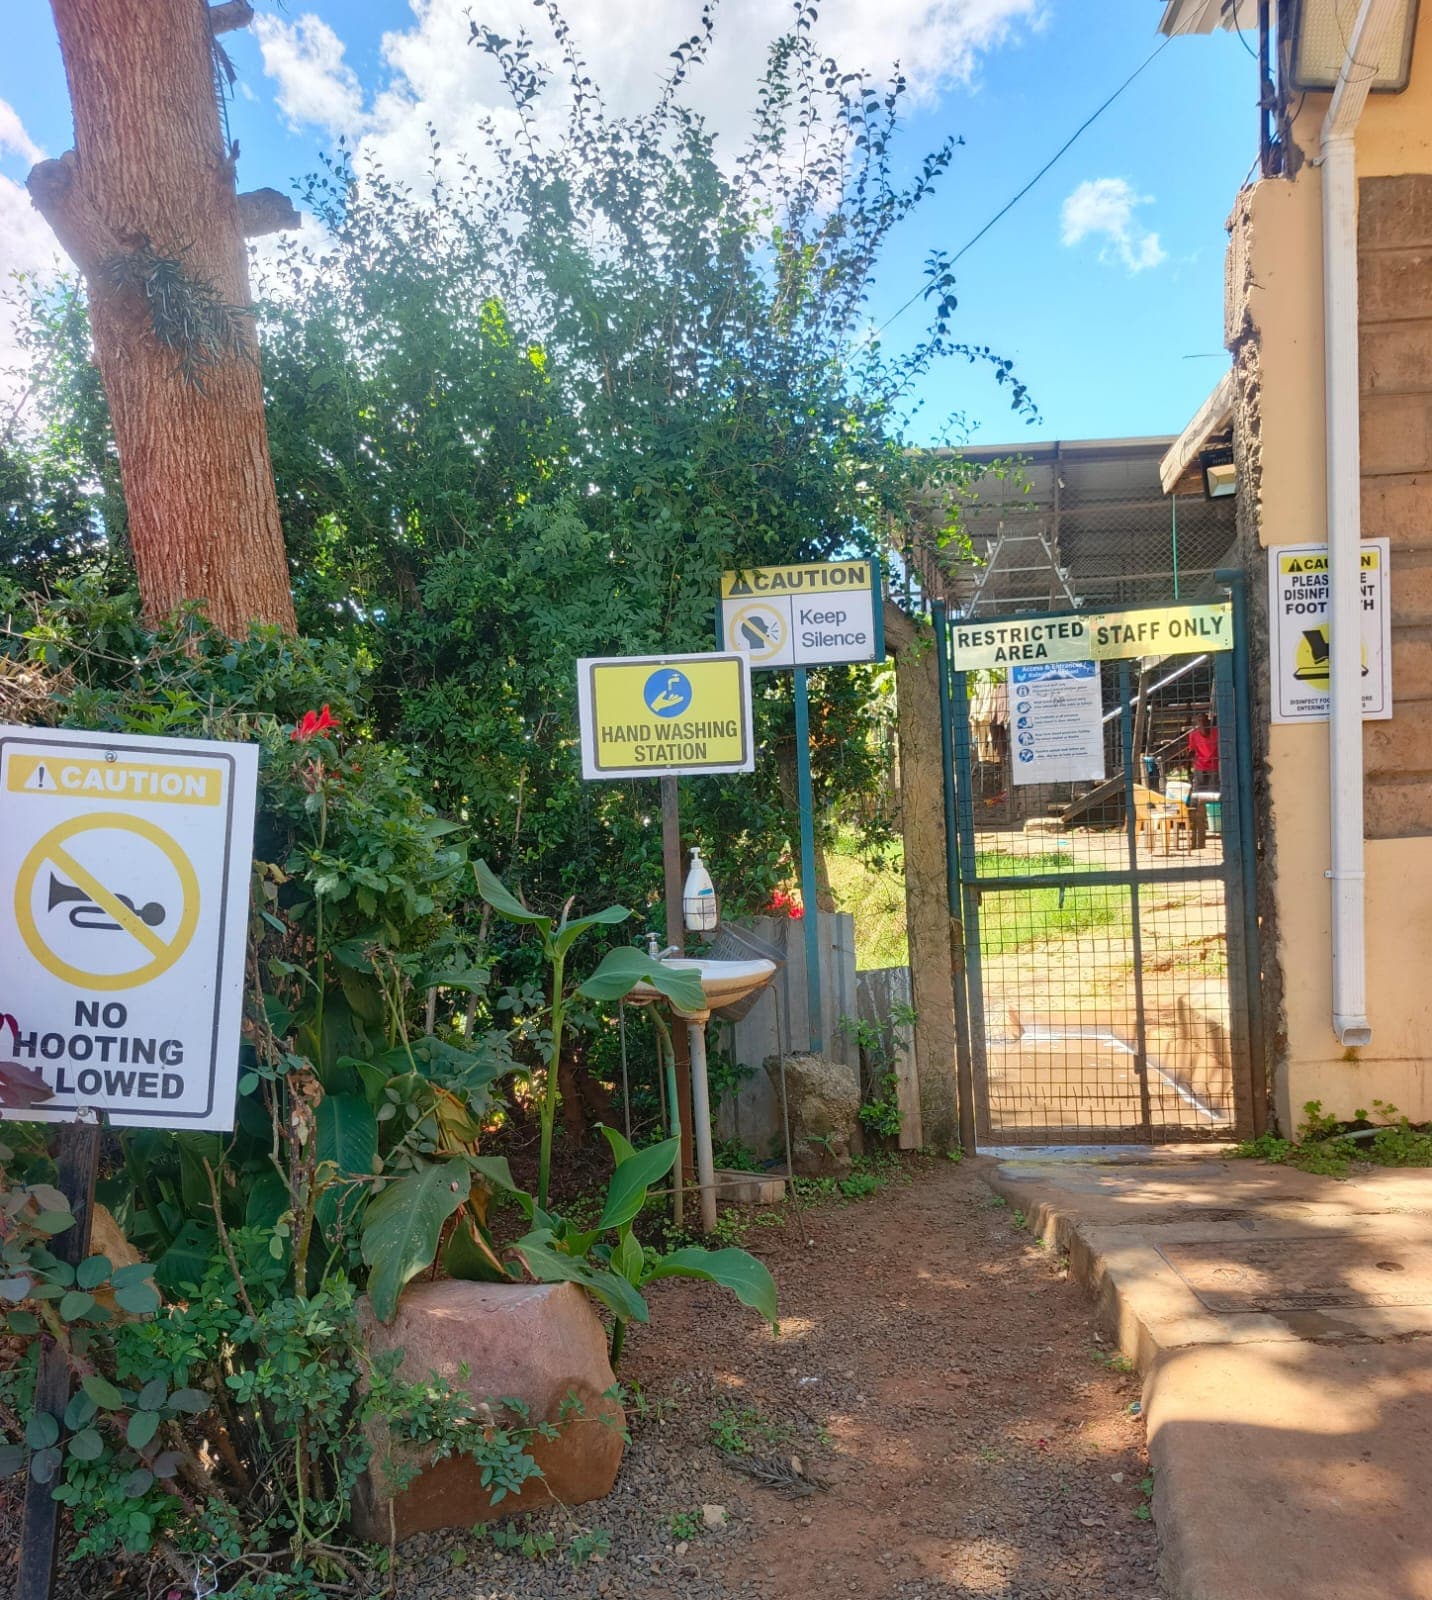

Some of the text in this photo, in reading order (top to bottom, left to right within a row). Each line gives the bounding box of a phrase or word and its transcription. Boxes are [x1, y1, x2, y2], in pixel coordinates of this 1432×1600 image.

[753, 567, 865, 591] CAUTION
[1291, 574, 1329, 588] PLEAS
[1284, 585, 1375, 601] DISINFNT
[799, 609, 847, 627] Keep
[1285, 602, 1328, 615] FOOT
[801, 631, 866, 648] Silence
[957, 621, 1084, 649] RESTRICTED
[1096, 616, 1223, 646] STAFF ONLY
[994, 643, 1048, 663] AREA
[601, 720, 737, 743] HAND WASHING
[634, 743, 707, 762] STATION
[60, 766, 207, 798] CAUTION
[74, 1000, 128, 1029] NO
[12, 1030, 184, 1066] HOOTING
[30, 1066, 185, 1100] LOWED
